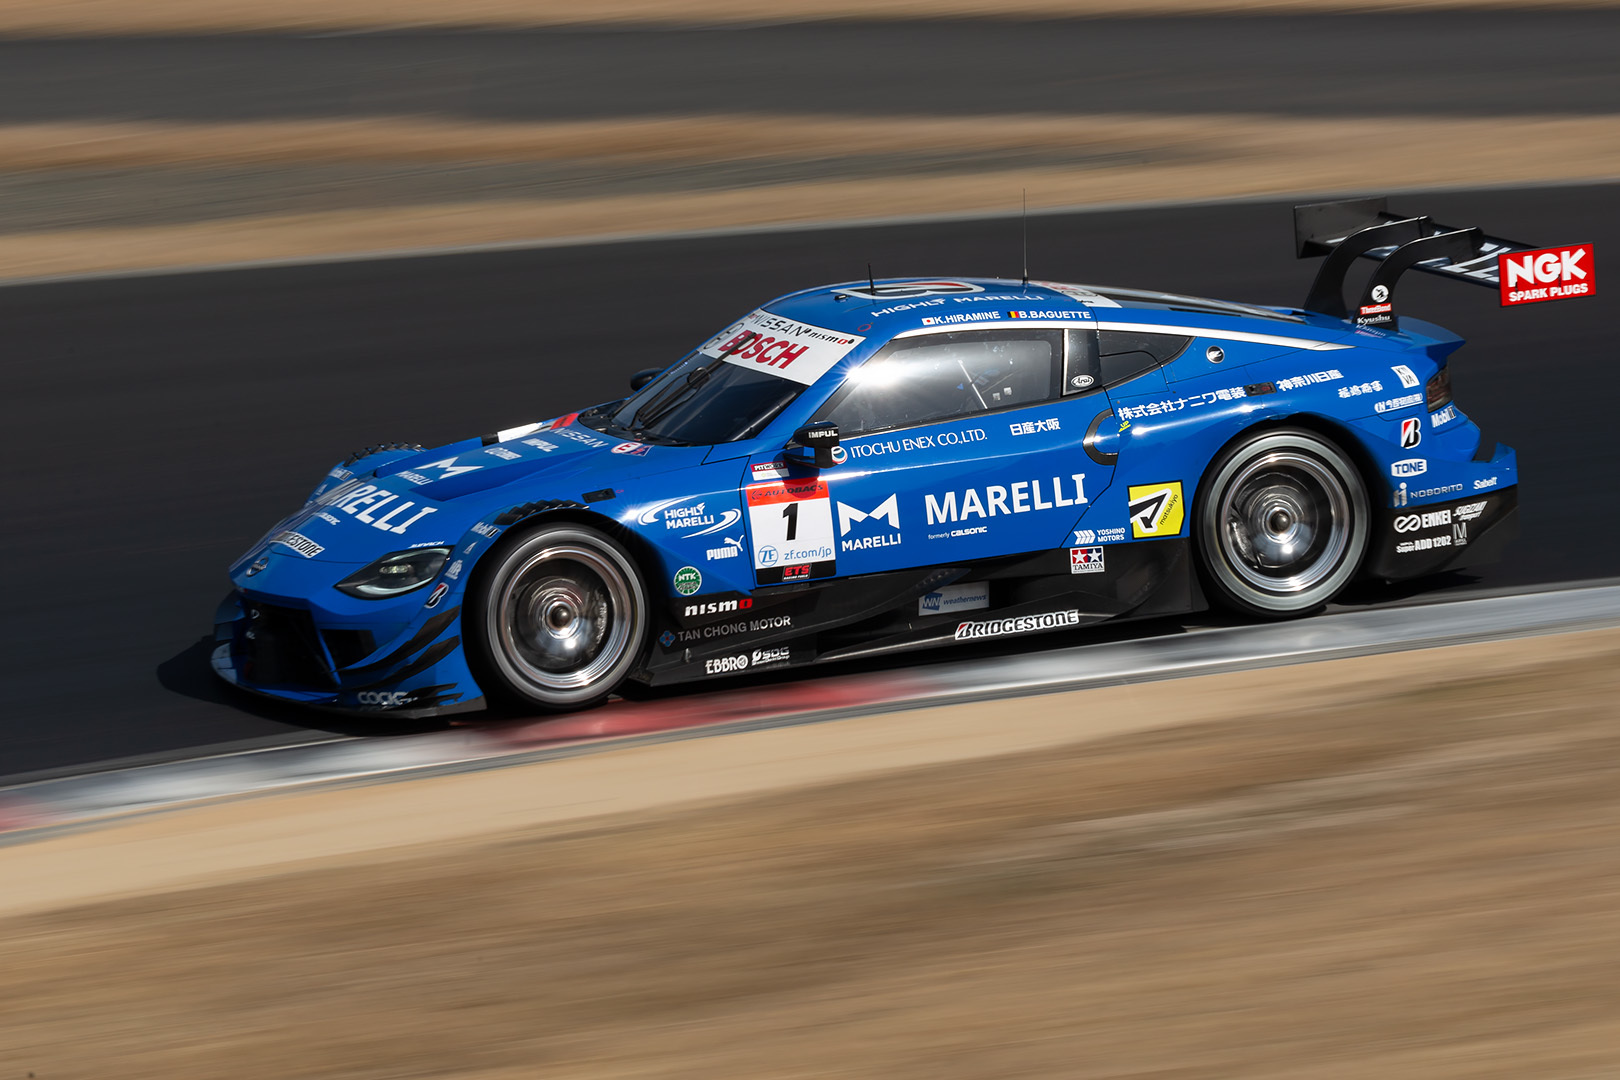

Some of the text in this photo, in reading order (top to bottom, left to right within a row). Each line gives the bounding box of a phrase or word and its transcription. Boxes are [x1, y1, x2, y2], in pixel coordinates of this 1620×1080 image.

[1507, 248, 1587, 287] NGK
[953, 294, 1045, 303] MARELLI
[1509, 283, 1588, 302] SPARK PLUGS
[752, 314, 803, 337] NISSAN
[934, 310, 1092, 325] K.HIRAMINE B.BAGUETTE
[1357, 315, 1390, 325] Kyushu
[718, 329, 809, 369] BOSCH
[1276, 369, 1344, 391] 神奈川日産
[1117, 386, 1247, 421] 株式会社ナニワ電装
[808, 430, 838, 439] IMPUL
[1010, 418, 1060, 436] 日産大阪
[550, 427, 609, 447] NISSAN
[850, 440, 901, 459] ITOCHU
[903, 435, 935, 452] ENEX
[1394, 461, 1424, 474] TONE
[764, 485, 823, 497] AUTOBACS
[924, 473, 1088, 525] MARELLI
[1410, 483, 1463, 498] NOBORITO
[664, 502, 705, 520] HIGHLY
[1159, 494, 1179, 526] matsukiyo
[1421, 510, 1451, 528] ENKEI
[666, 515, 714, 530] MARELLI
[782, 503, 798, 540] 1
[928, 532, 950, 540] formerly
[1097, 528, 1125, 536] YOSHINO
[1098, 534, 1125, 542] MOTORS
[842, 533, 901, 551] MARELLI
[706, 546, 738, 560] PUMA
[760, 546, 832, 562] ZF zf.com/jp
[785, 565, 810, 576] ETS
[1073, 563, 1103, 571] TAMIYA
[679, 572, 696, 581] NTK
[943, 594, 987, 605] weathernews
[678, 616, 791, 642] TAN CHONG MOTOR
[956, 610, 1078, 639] BRIDGESTONE
[705, 655, 748, 674] EBBRO
